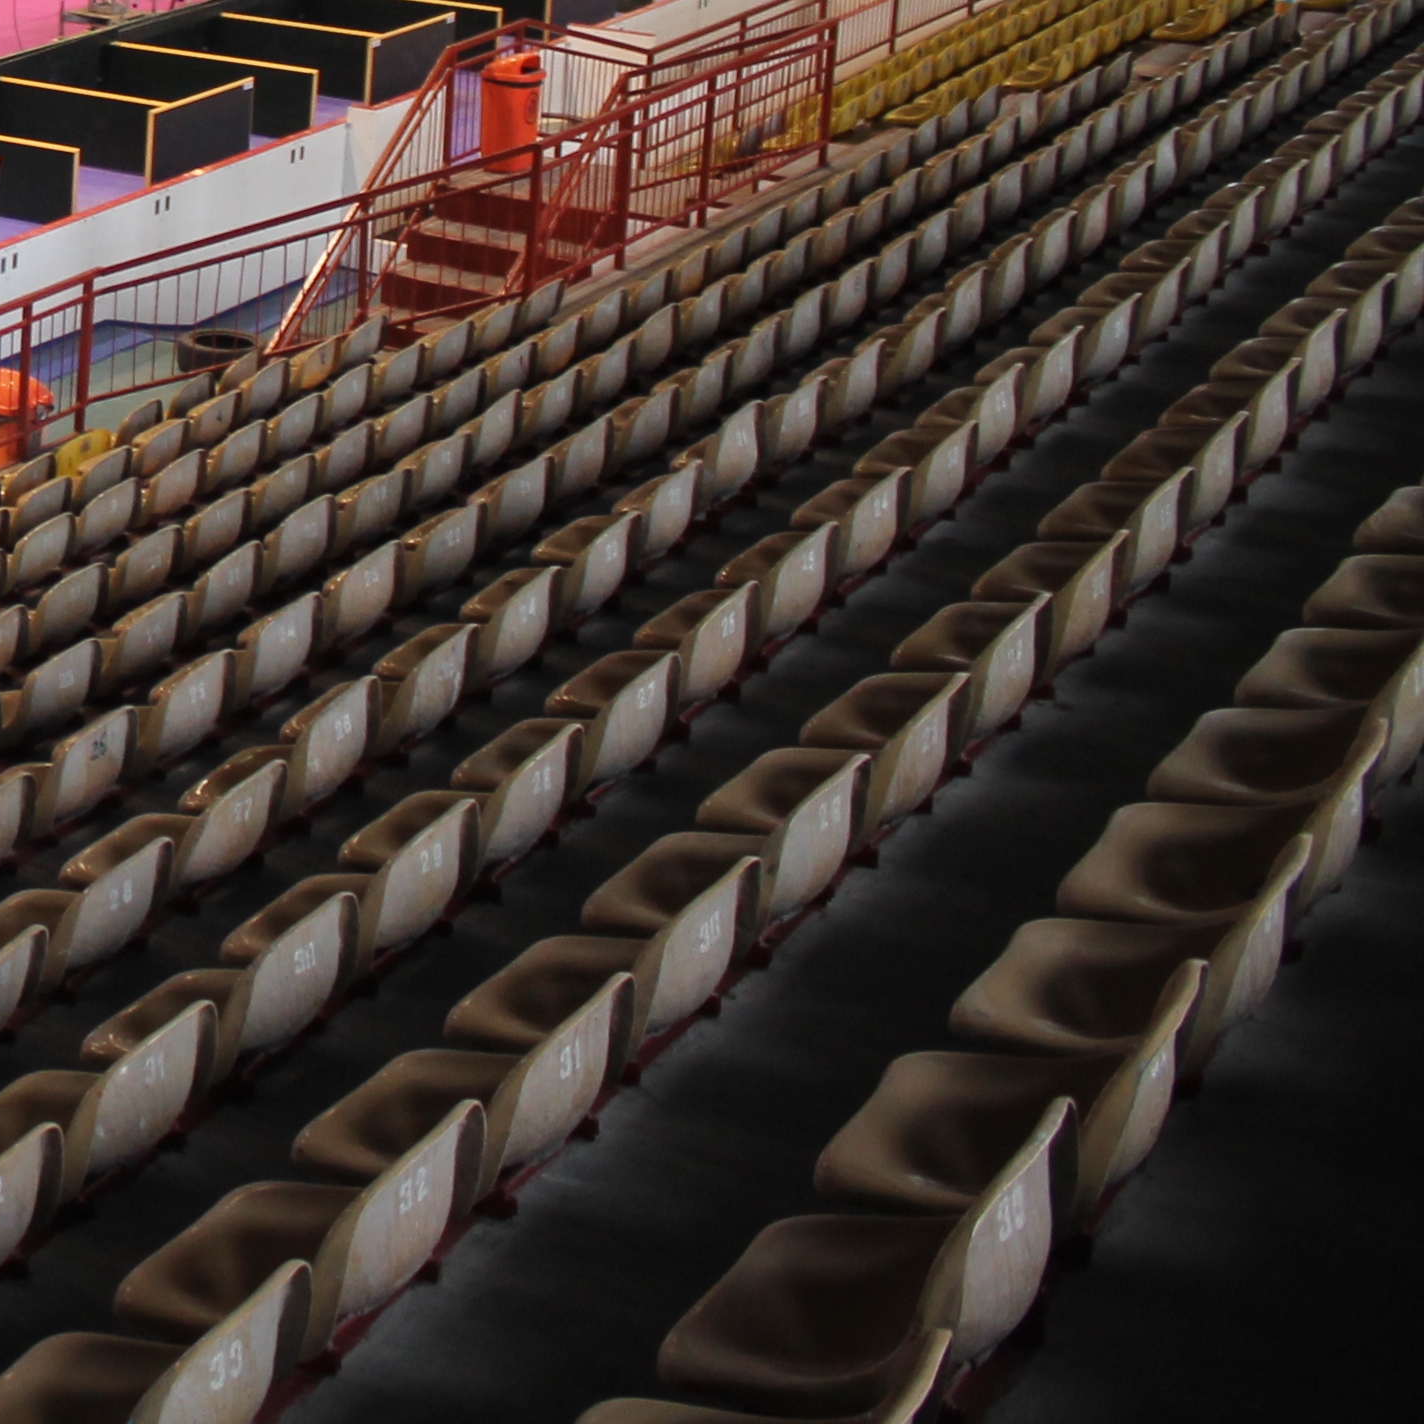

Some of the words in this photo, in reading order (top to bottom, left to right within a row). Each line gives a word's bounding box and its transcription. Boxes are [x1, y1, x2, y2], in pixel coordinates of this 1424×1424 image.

[639, 680, 656, 710] 27
[144, 1053, 167, 1084] 31
[559, 1039, 581, 1081] 31
[399, 1166, 429, 1215] 32
[210, 1339, 243, 1390] 33
